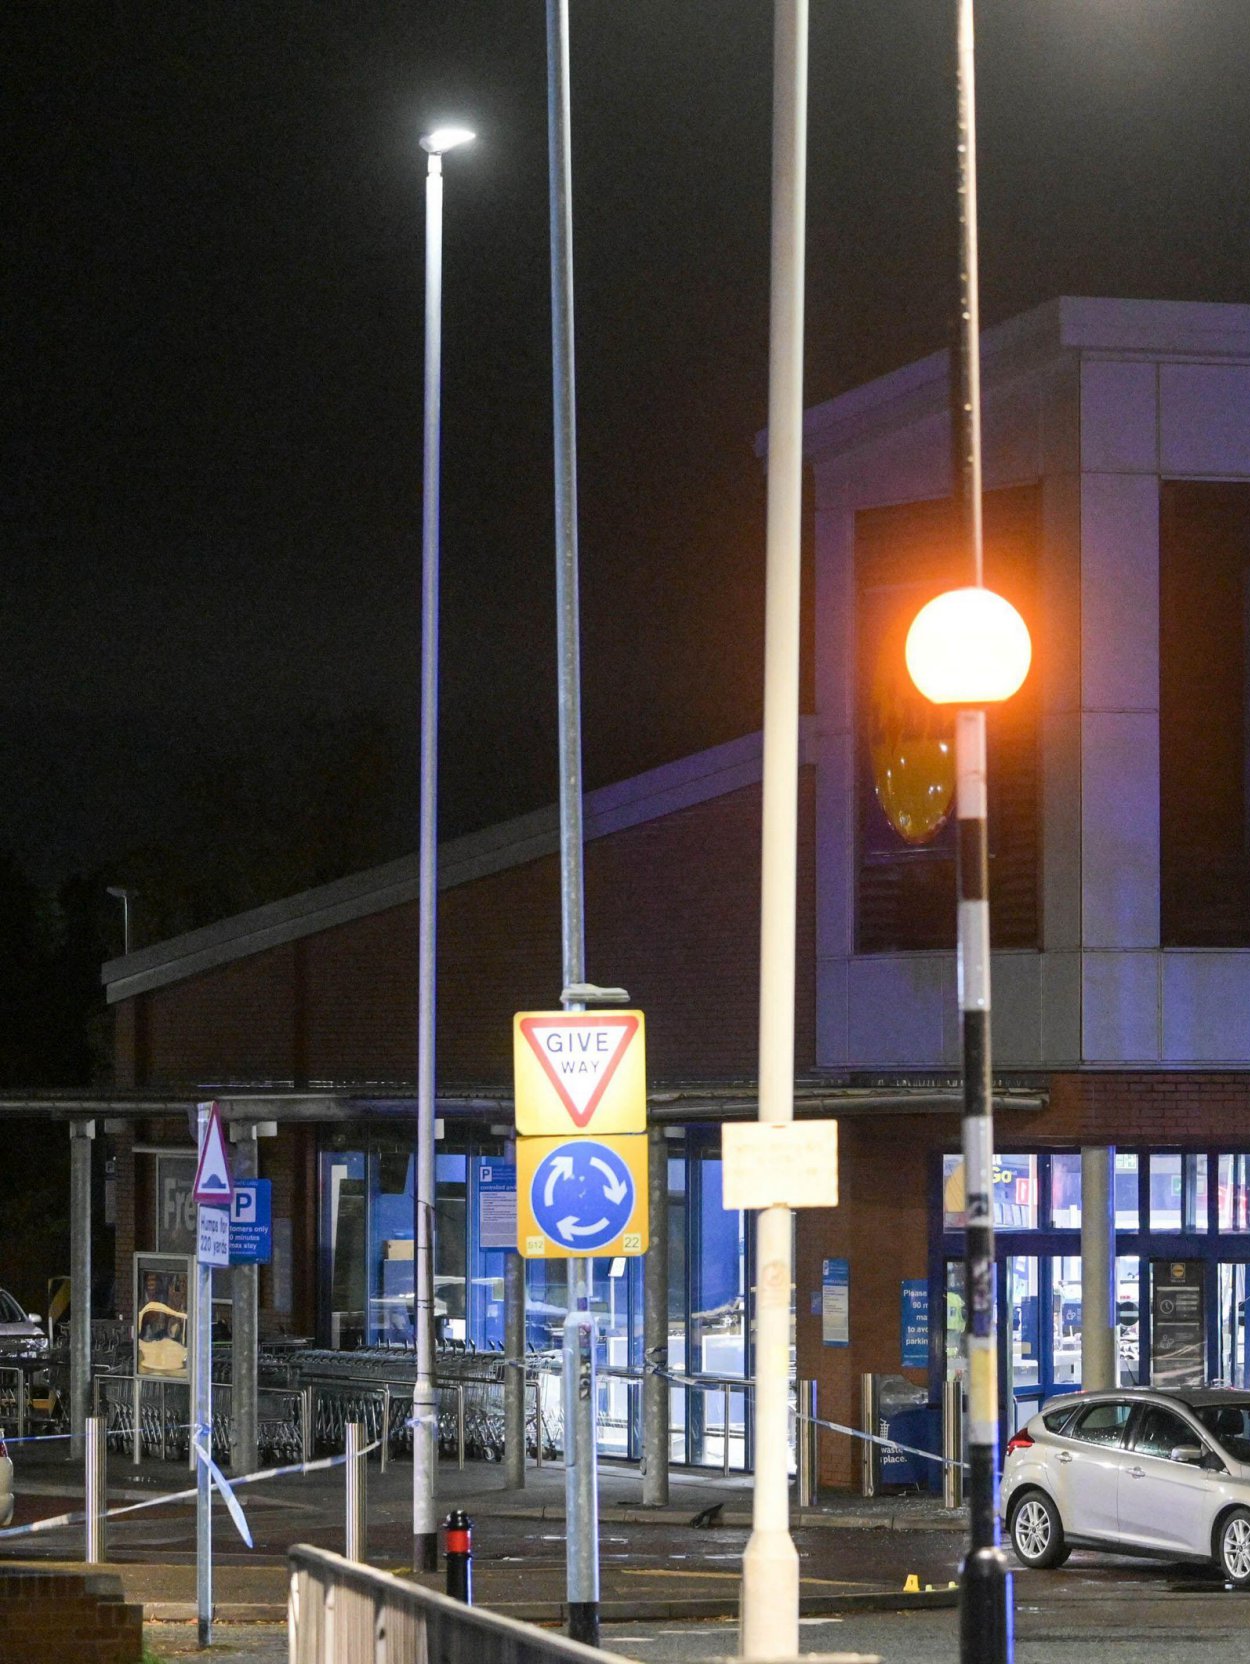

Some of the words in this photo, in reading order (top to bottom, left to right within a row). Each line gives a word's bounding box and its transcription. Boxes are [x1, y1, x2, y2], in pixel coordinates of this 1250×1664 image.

[547, 1032, 609, 1053] GIVE
[561, 1061, 600, 1074] WAY
[236, 1193, 253, 1218] P
[254, 1225, 269, 1234] only
[235, 1233, 260, 1241] minutes
[200, 1234, 212, 1252] 220
[213, 1240, 228, 1256] yards
[243, 1242, 258, 1251] stay
[624, 1236, 640, 1249] 22
[903, 1289, 928, 1297] Please
[907, 1325, 915, 1333] to
[906, 1337, 928, 1346] parkin
[883, 1454, 908, 1465] place.
